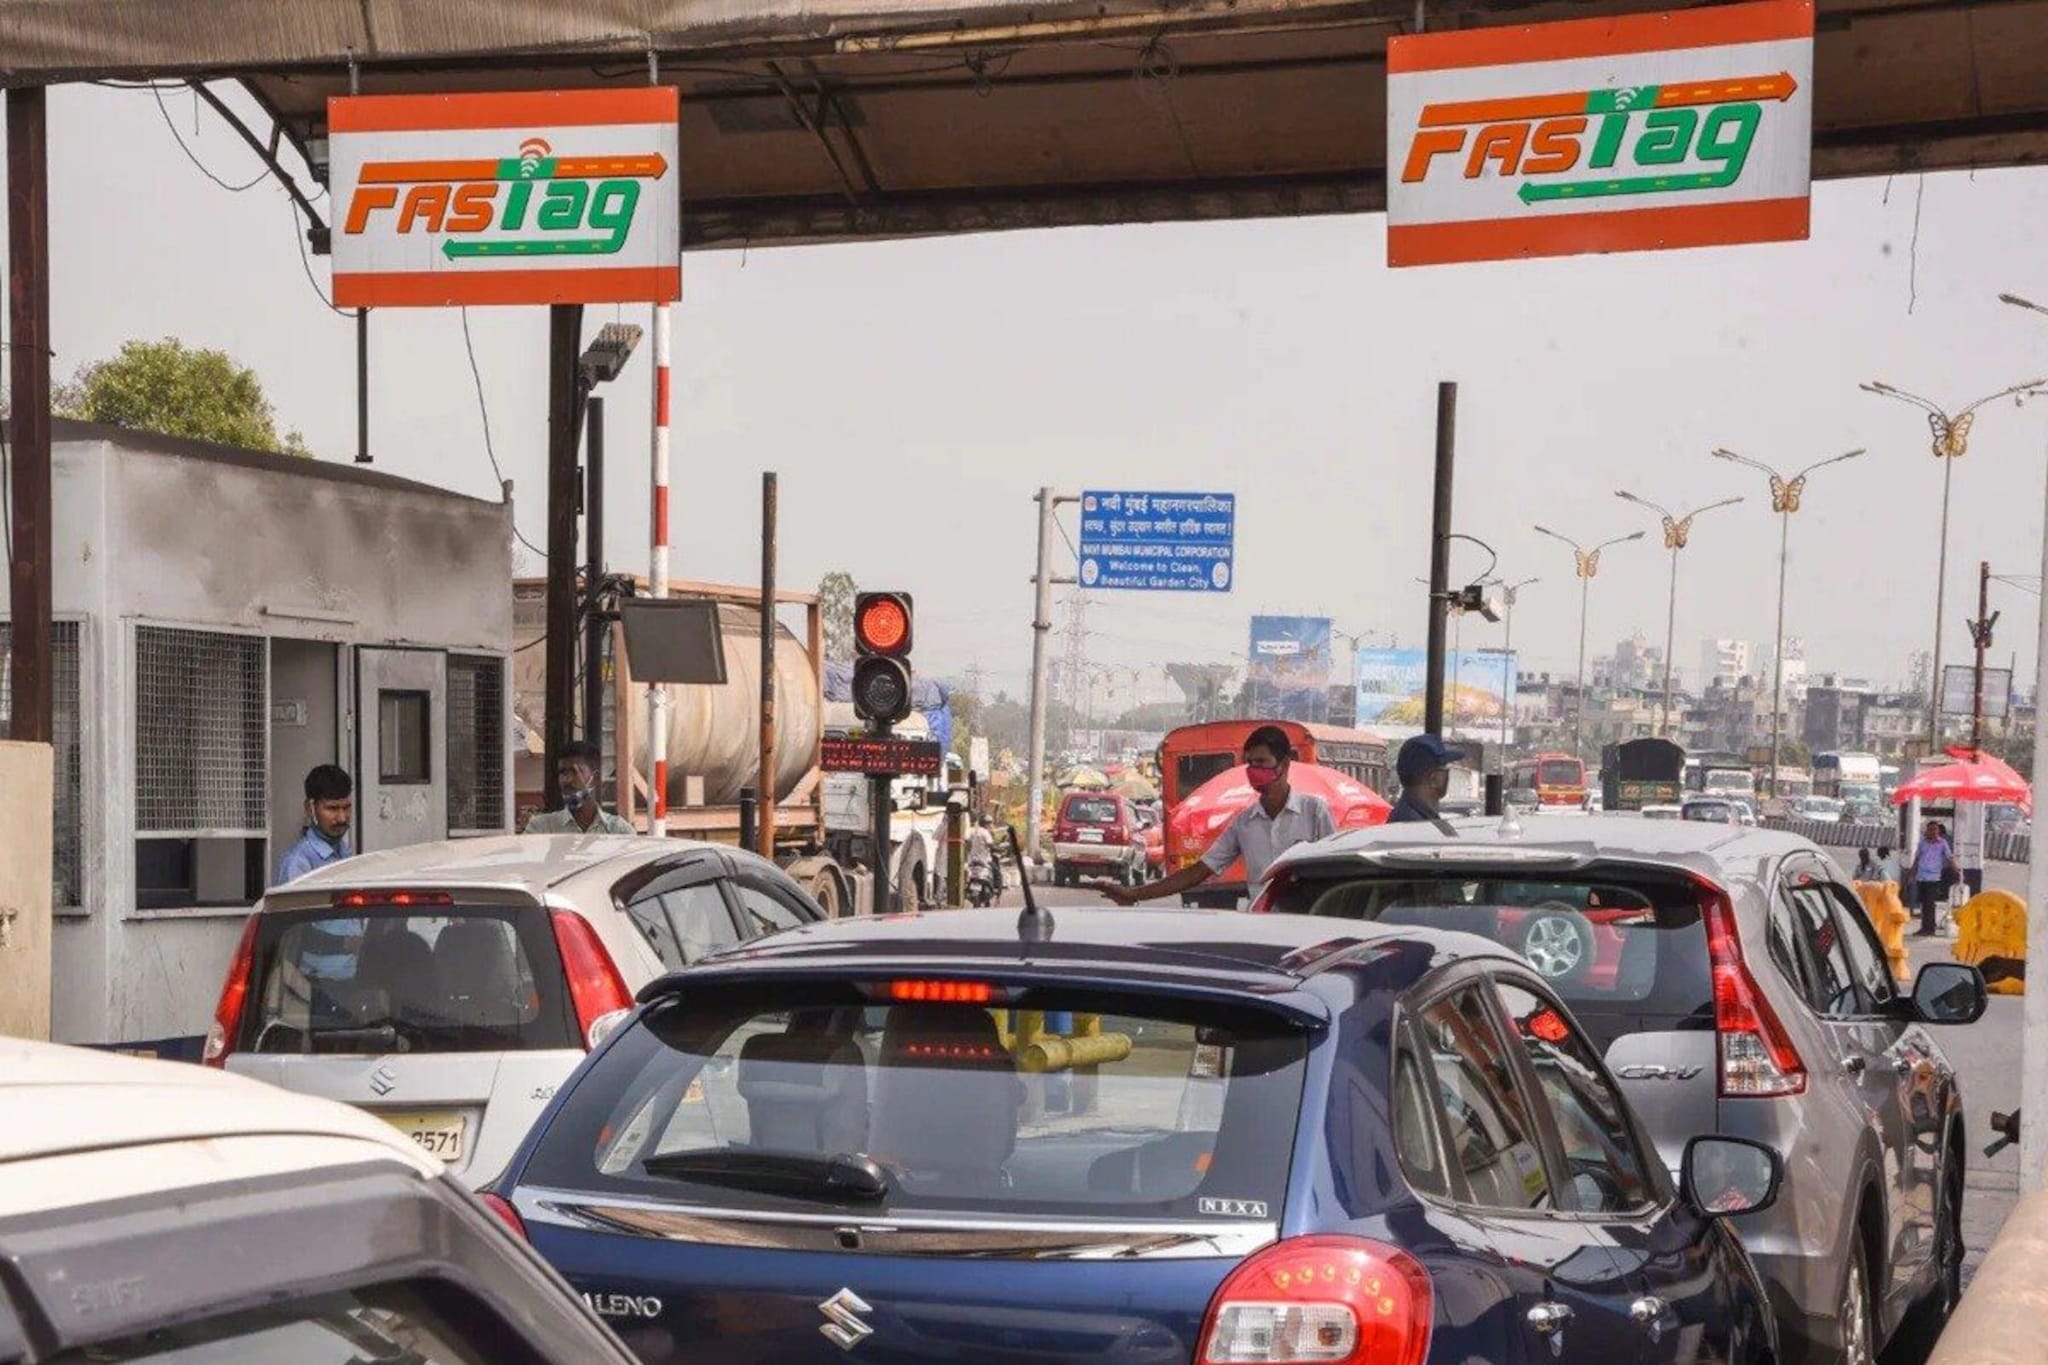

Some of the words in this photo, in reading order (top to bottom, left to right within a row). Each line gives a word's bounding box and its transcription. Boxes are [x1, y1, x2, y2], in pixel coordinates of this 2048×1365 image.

[1175, 546, 1230, 558] CORPORATION
[1109, 561, 1154, 572] Welcome
[1157, 561, 1167, 572] to
[1101, 576, 1147, 587] Beautiful
[1149, 576, 1185, 588] Garden
[1188, 577, 1209, 590] City
[1205, 1200, 1263, 1215] NEXA
[582, 1291, 662, 1318] LENO
